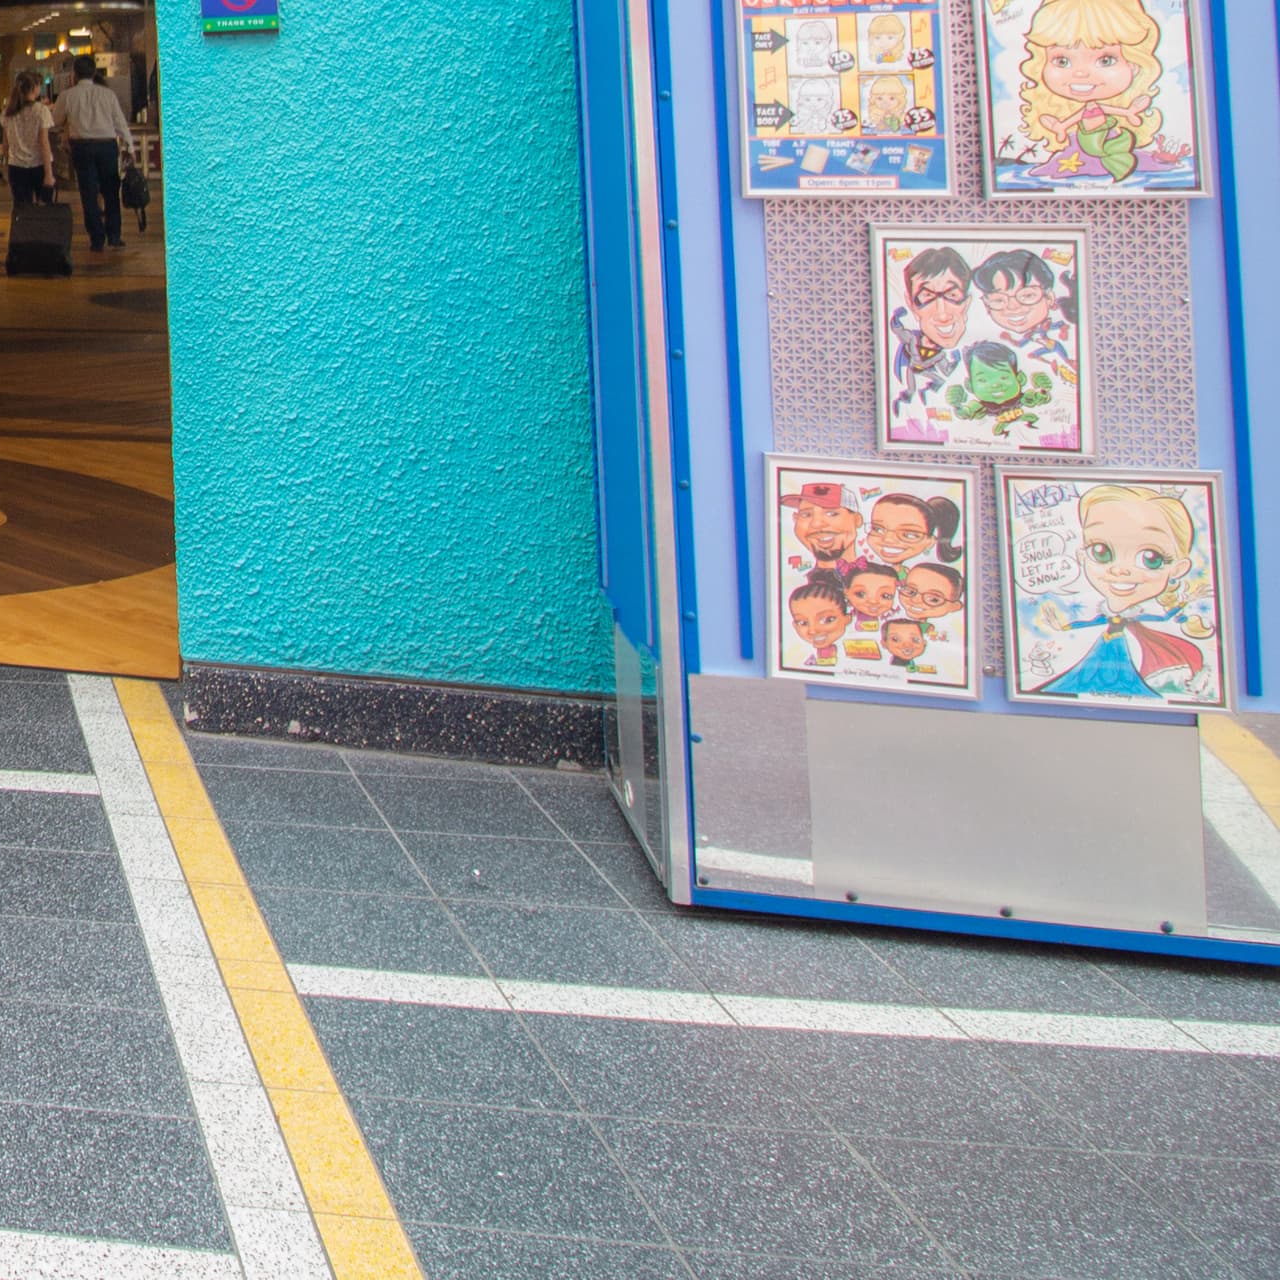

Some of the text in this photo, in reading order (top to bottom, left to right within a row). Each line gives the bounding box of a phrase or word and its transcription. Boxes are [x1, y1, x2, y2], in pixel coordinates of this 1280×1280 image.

[755, 33, 771, 41] FACE
[755, 40, 773, 48] ONLY
[756, 108, 776, 116] FACE
[757, 116, 780, 126] BODY
[1020, 535, 1054, 553] LET IT
[1021, 561, 1056, 578] LET IT
